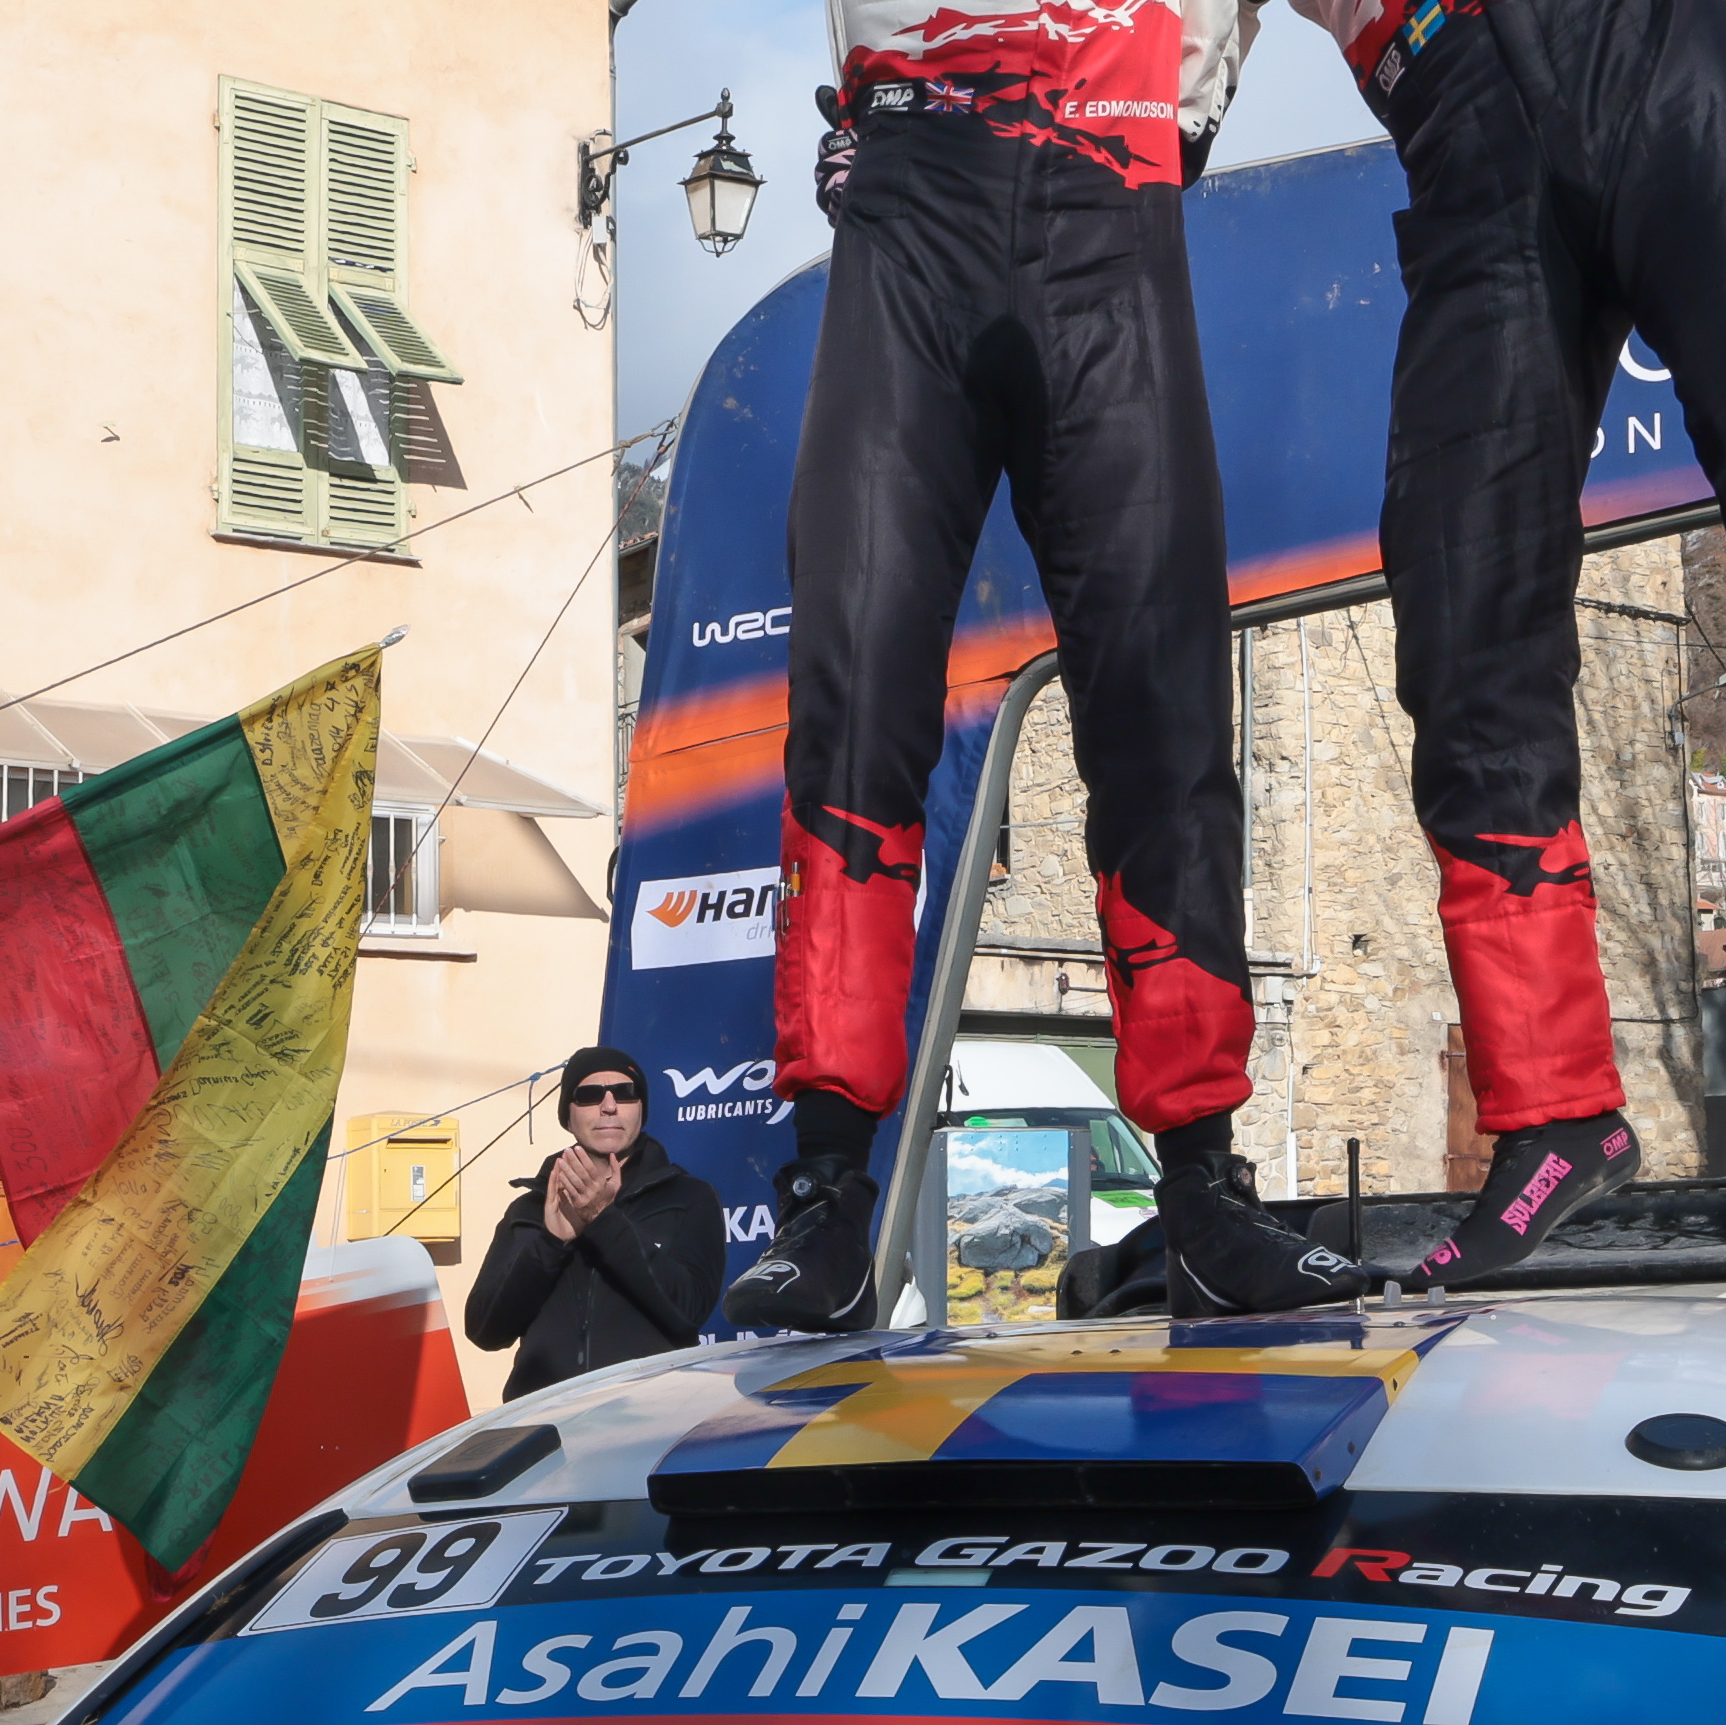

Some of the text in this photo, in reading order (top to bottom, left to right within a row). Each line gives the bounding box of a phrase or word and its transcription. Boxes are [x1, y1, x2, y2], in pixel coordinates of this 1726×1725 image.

[871, 88, 915, 108] OMP
[1064, 100, 1174, 120] E. EDMONDSON
[678, 1099, 773, 1122] LUBRICANTS
[1603, 1131, 1630, 1156] OMP
[1500, 1152, 1573, 1236] SOLBERG
[309, 1521, 503, 1618] 99
[532, 1536, 1691, 1618] TOYOTA GAZOO Racing
